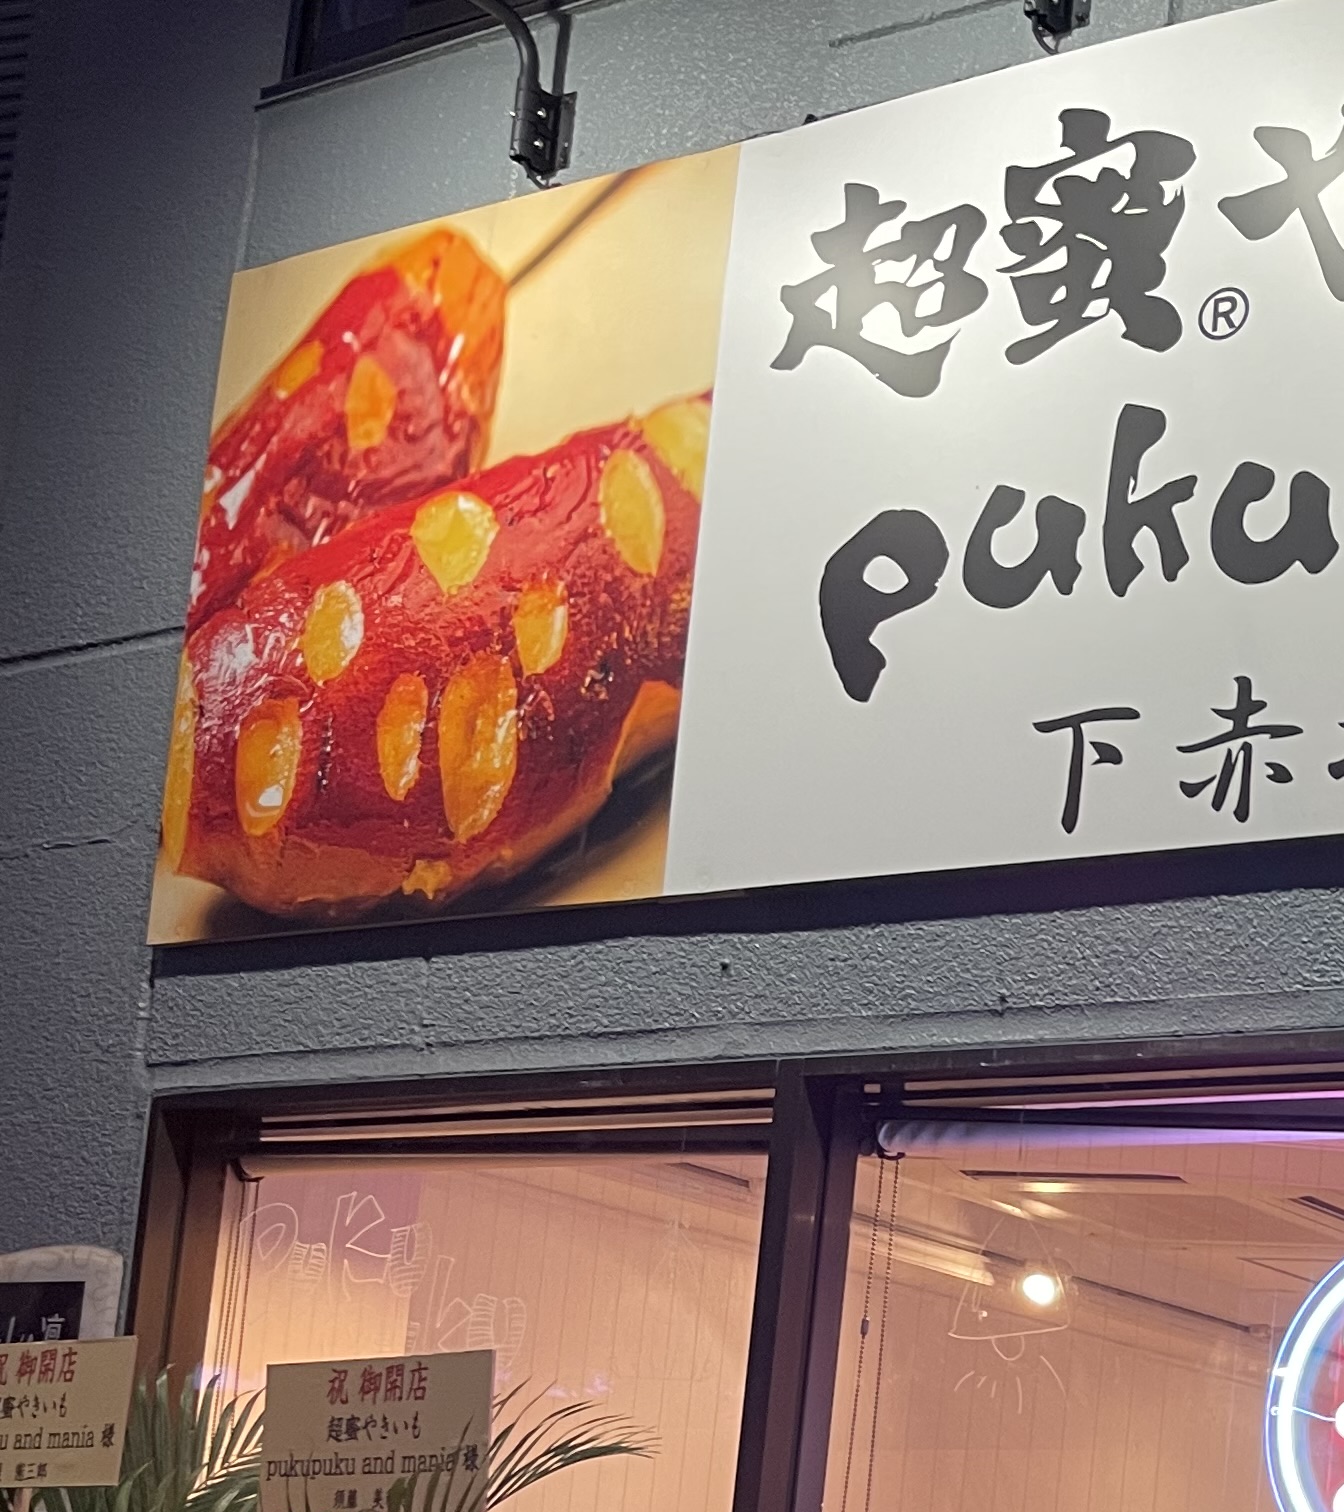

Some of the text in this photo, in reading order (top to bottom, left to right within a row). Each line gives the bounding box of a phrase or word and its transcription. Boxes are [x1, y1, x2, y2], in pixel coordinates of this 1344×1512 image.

[16, 1347, 78, 1387] 御開店
[326, 1360, 430, 1406] 祝 御開店
[13, 1427, 43, 1450] and
[47, 1423, 95, 1448] mania
[326, 1411, 422, 1442] 超蜜やきいも
[266, 1452, 356, 1481] pukupuku
[361, 1450, 395, 1475] and
